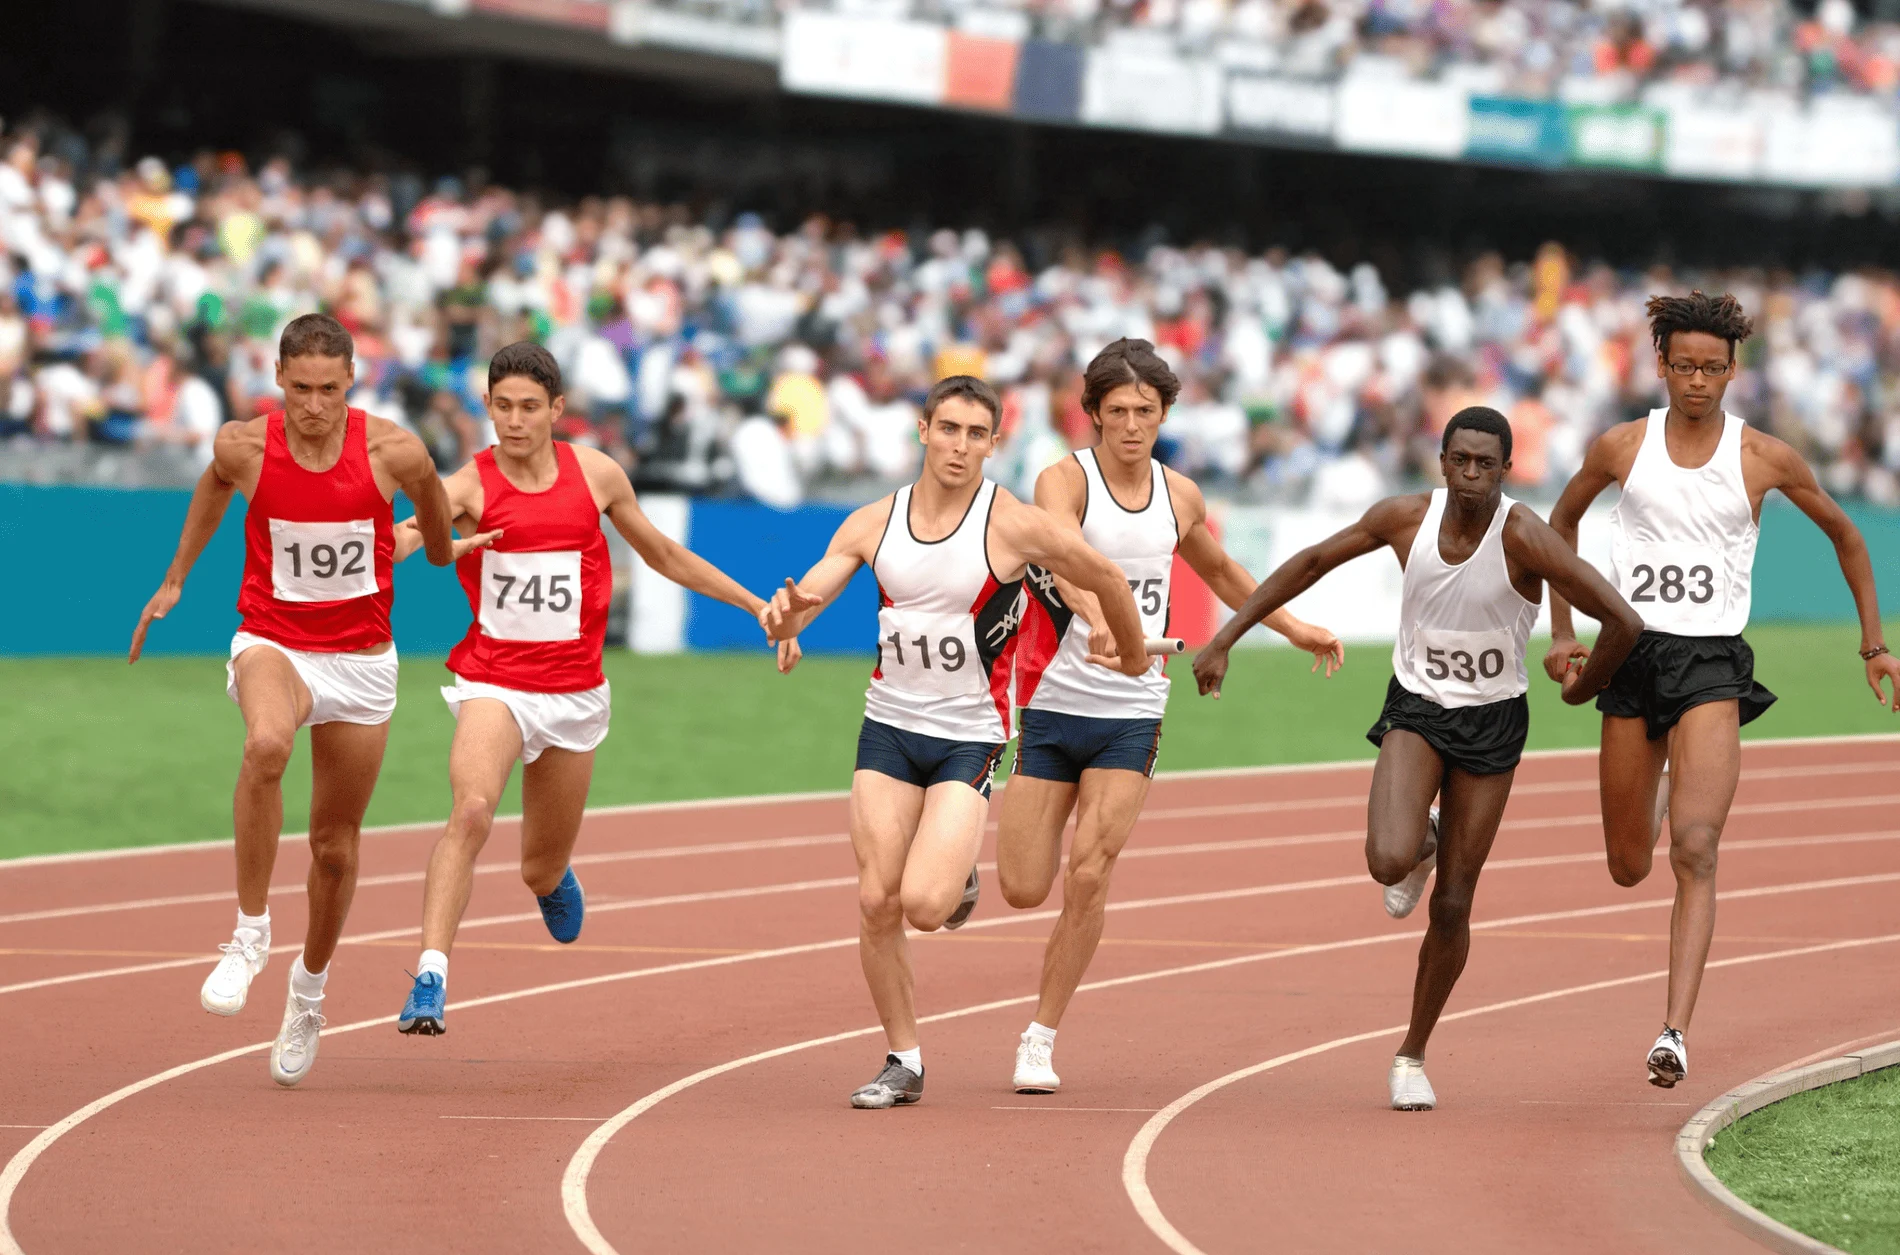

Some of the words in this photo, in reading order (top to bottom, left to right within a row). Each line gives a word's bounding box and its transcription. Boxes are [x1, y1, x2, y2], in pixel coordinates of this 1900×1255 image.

[284, 541, 366, 579] 192
[493, 573, 573, 613] 745
[1630, 564, 1714, 604] 283
[887, 631, 966, 672] 119
[1425, 646, 1504, 683] 530
